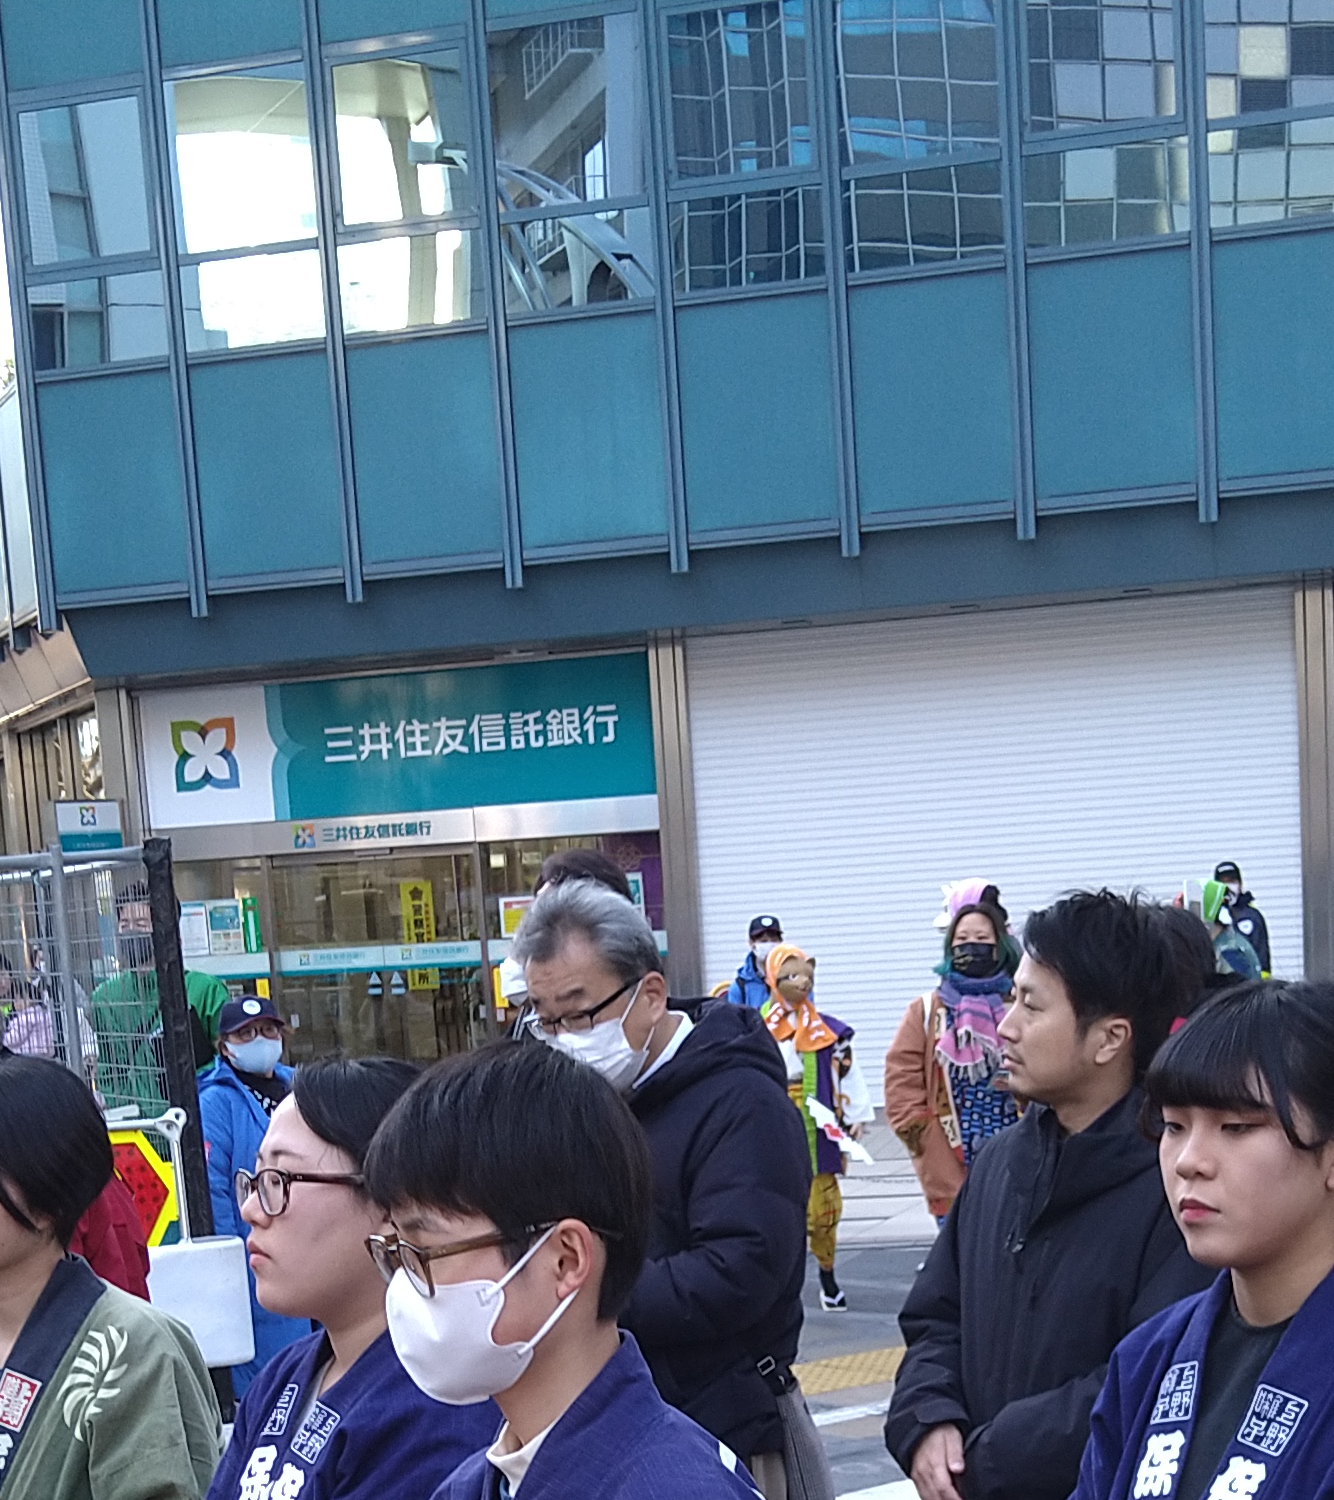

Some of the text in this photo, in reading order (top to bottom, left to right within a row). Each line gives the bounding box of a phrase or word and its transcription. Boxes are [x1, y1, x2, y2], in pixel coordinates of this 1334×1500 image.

[323, 703, 620, 764] 三井住友信託銀行
[322, 821, 432, 842] 三井住友信託銀行
